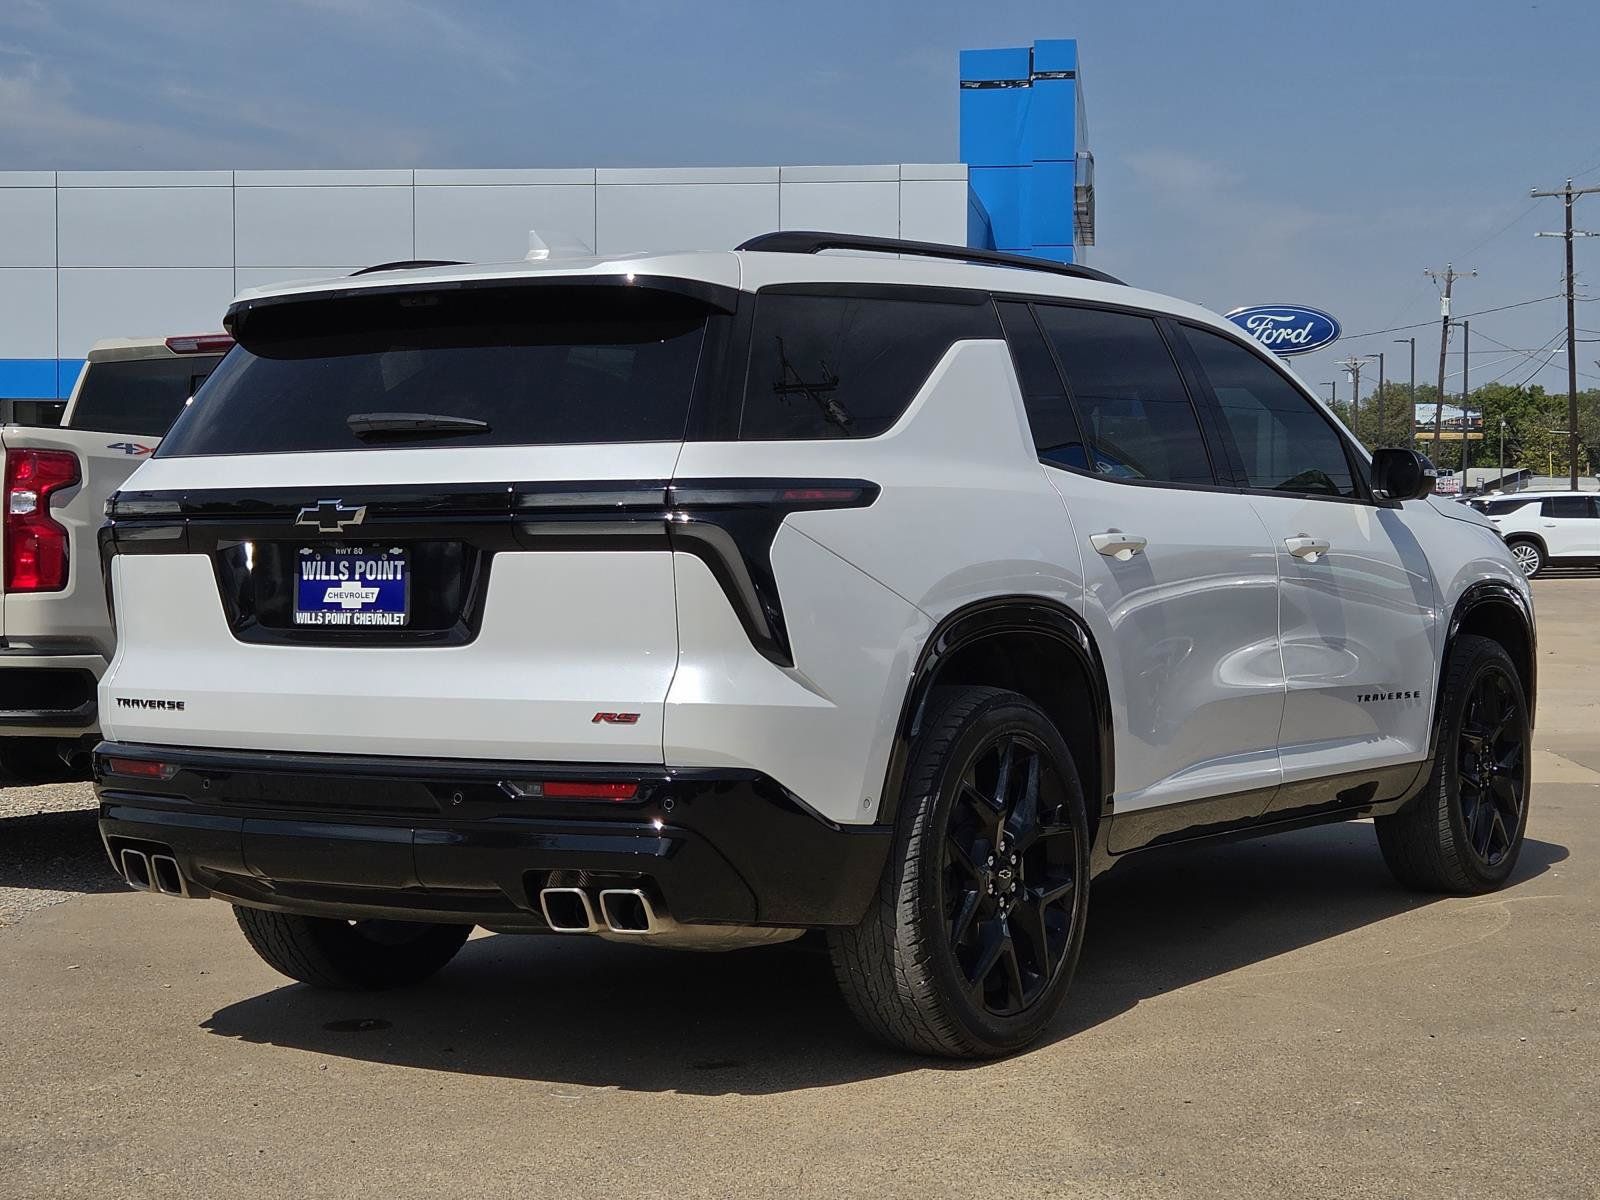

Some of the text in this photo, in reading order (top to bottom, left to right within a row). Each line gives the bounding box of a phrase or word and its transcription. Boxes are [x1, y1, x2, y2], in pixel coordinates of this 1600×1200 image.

[1246, 314, 1314, 344] Ford
[335, 547, 363, 555] HWY 80
[301, 560, 405, 580] WILLS POINT
[327, 591, 375, 599] CHEVROLET
[296, 612, 405, 625] WILLS POINT CHEVROLET
[1357, 690, 1421, 703] TRAVERSE
[115, 697, 185, 711] TRAVERSE
[591, 712, 641, 724] RS
